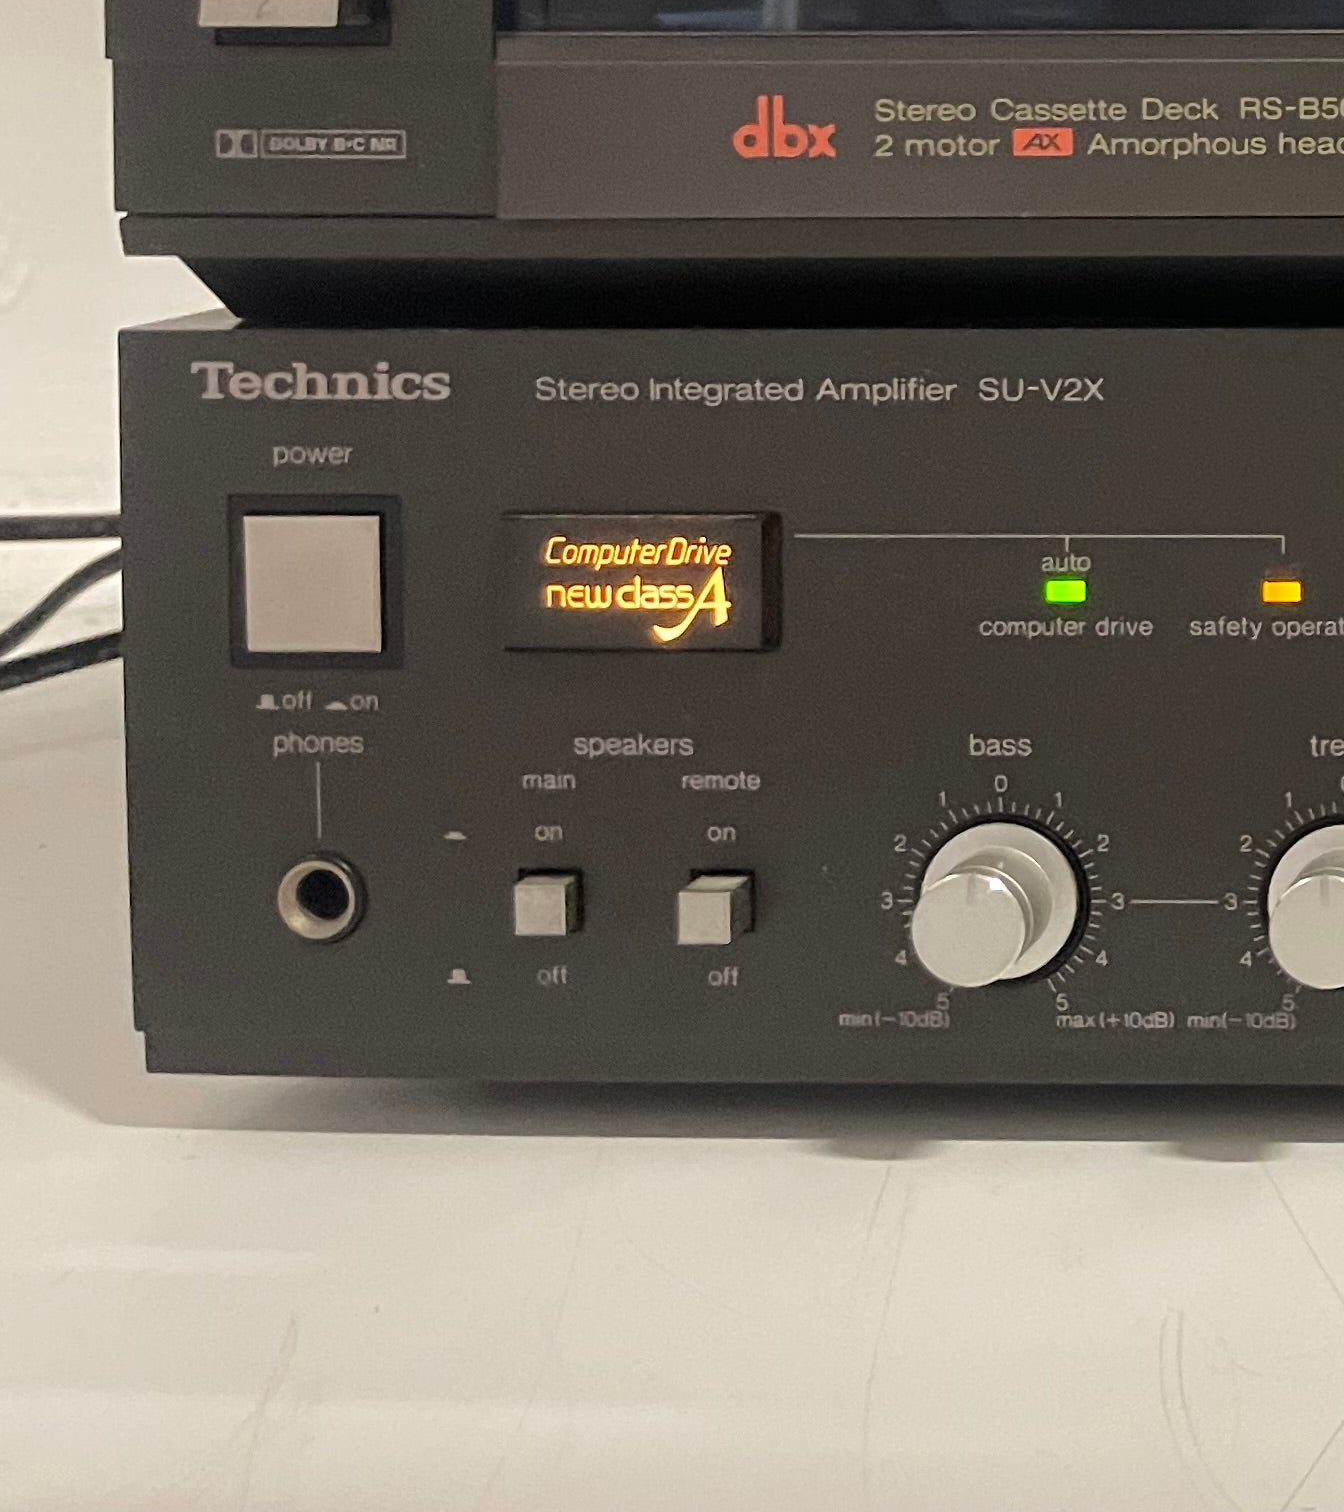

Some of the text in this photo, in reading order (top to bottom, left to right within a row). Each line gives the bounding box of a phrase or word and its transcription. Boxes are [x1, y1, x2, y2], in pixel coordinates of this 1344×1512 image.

[874, 98, 976, 122] Stereo
[990, 97, 1127, 122] Cassette
[1141, 97, 1219, 120] Deck
[732, 94, 836, 158] dbx
[874, 134, 893, 157] 2
[904, 134, 1000, 157] motor
[1022, 134, 1062, 152] AX
[1086, 132, 1267, 160] Amorphous
[190, 362, 450, 400] Technics
[535, 376, 1104, 406] Stereo Integrated Amplifier SU-V2X
[272, 444, 352, 467] power
[1041, 552, 1092, 572] auto
[979, 616, 1154, 639] computer drive
[1190, 616, 1262, 640] safety
[273, 732, 364, 757] phones
[574, 734, 694, 758] speakers
[969, 734, 1032, 756] bass
[522, 772, 576, 790] main
[682, 770, 760, 790] remote
